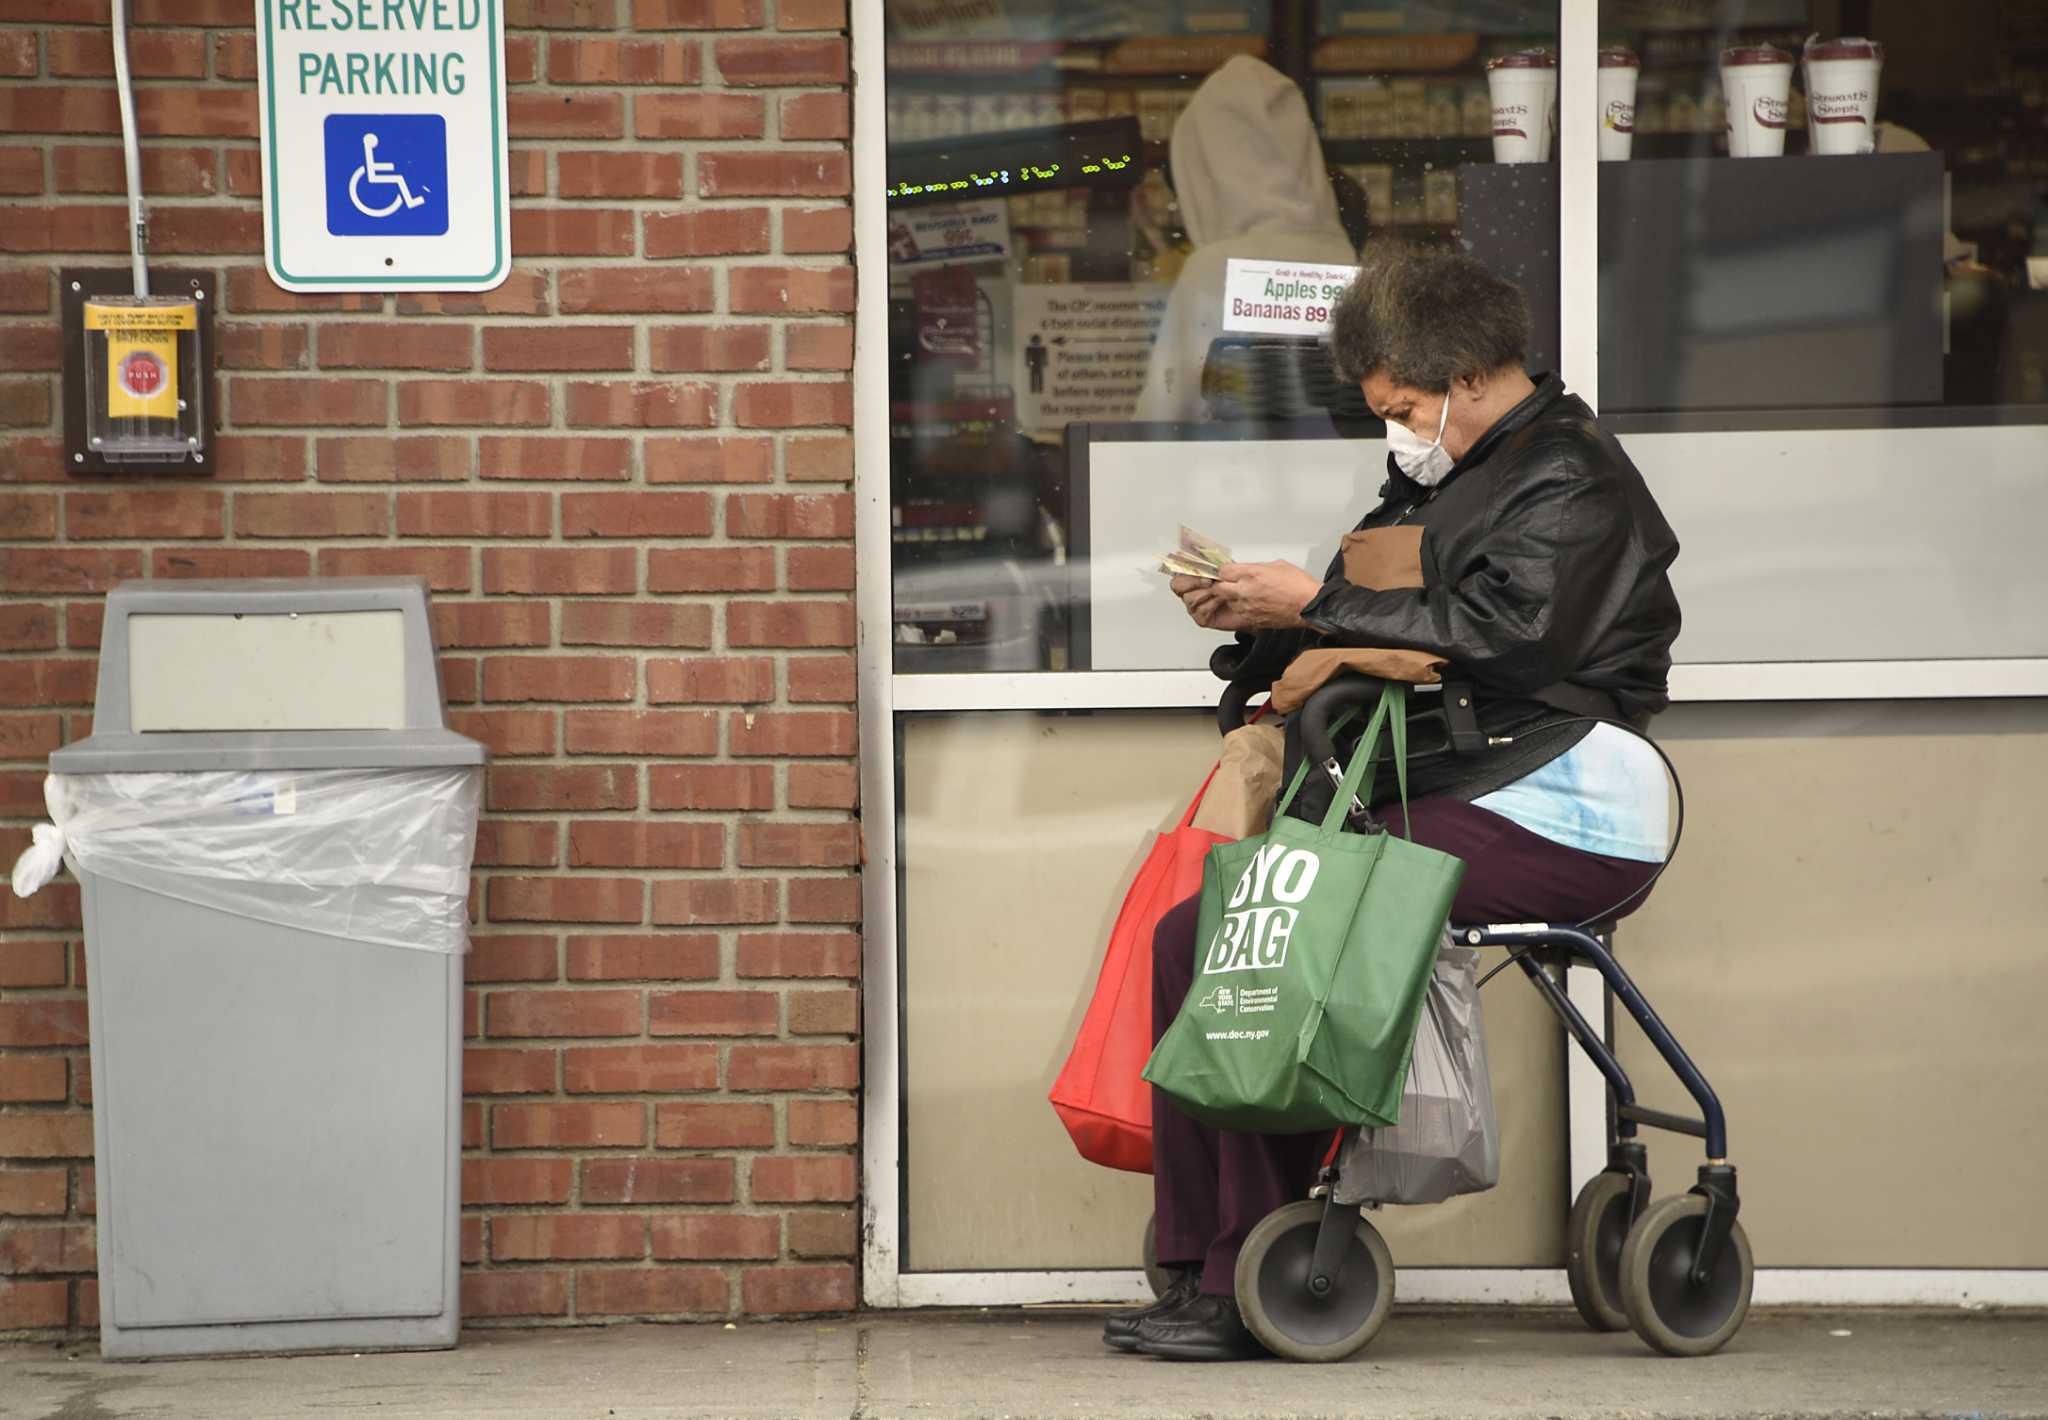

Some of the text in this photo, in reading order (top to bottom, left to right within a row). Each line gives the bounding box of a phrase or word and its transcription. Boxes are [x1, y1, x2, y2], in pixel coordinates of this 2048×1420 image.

[279, 0, 480, 31] RESERVED
[298, 52, 466, 95] PARKING
[1263, 277, 1318, 301] Apples
[1232, 297, 1302, 320] Bananas
[128, 371, 157, 380] PUSH
[1228, 843, 1320, 908] BYO
[1207, 908, 1292, 971] BAG
[1240, 985, 1278, 998] Department of
[1240, 995, 1279, 1006] Environmental
[1240, 1004, 1275, 1013] Conservation
[1206, 1029, 1270, 1040] www.dec.ny.gov
